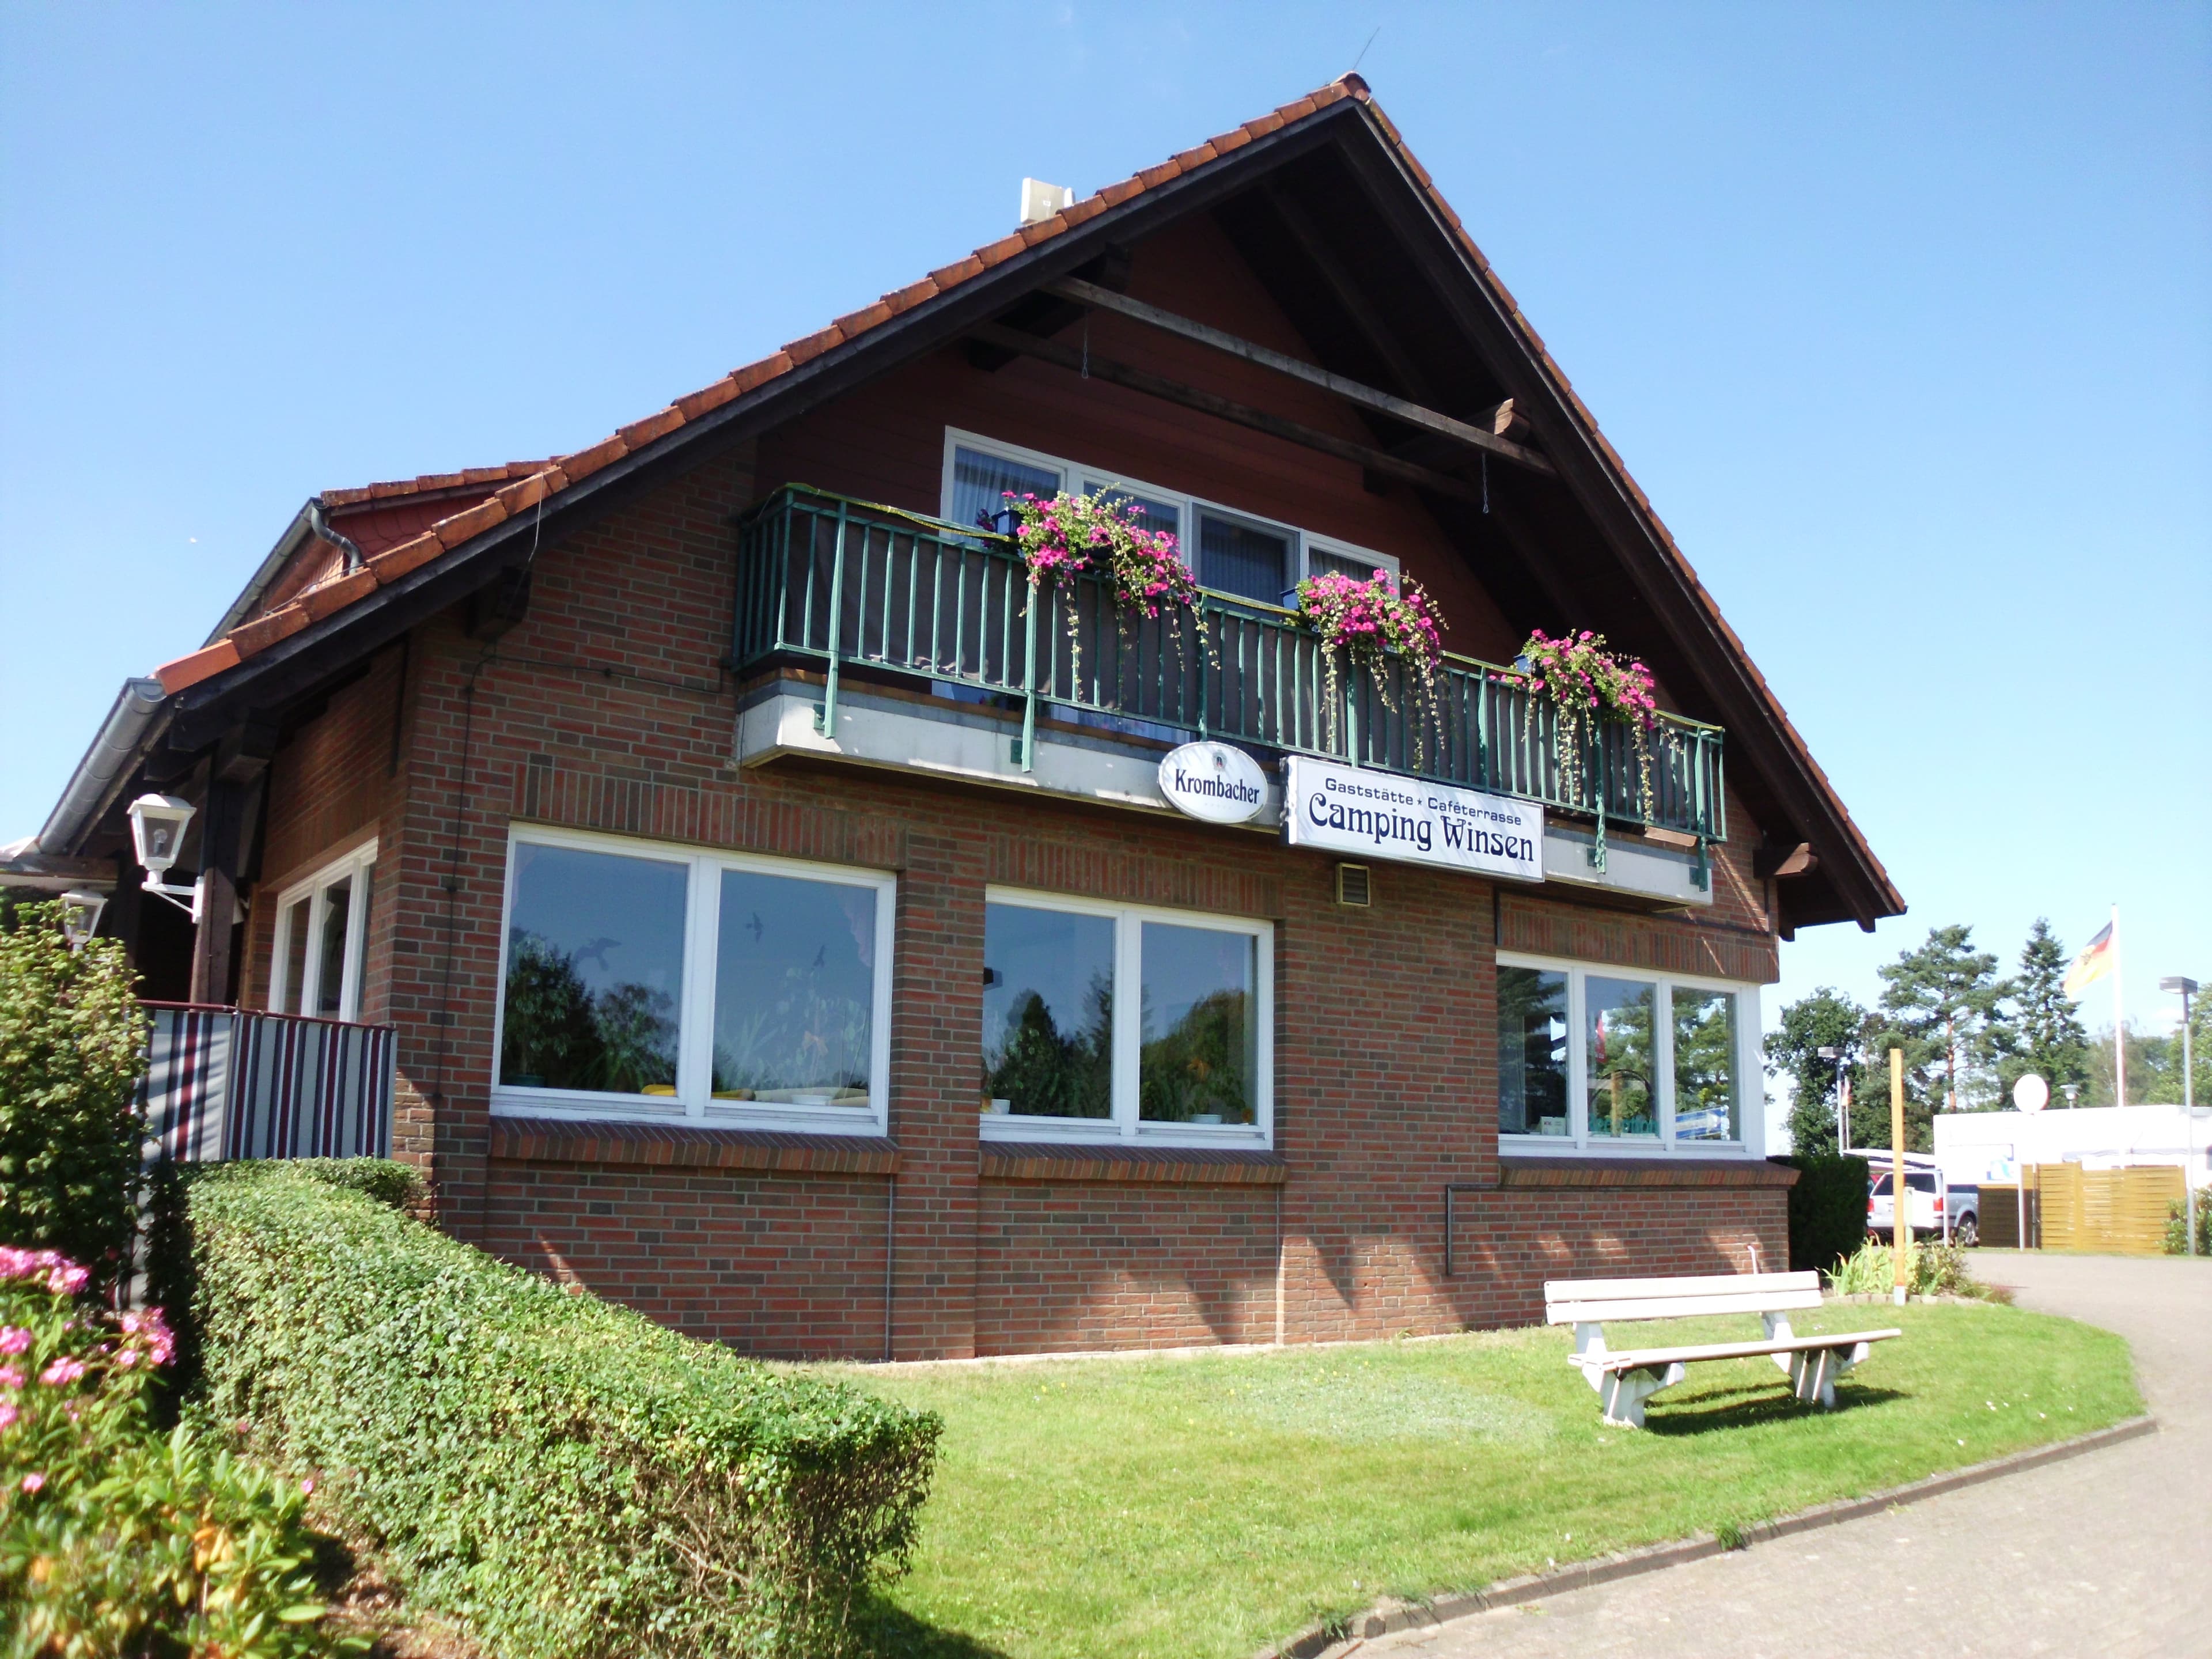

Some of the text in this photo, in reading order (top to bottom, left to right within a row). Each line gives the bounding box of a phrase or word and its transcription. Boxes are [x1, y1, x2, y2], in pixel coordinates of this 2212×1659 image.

[1175, 769, 1260, 804] Krombacher
[1325, 778, 1521, 825] Gaststätte Caféterrasse
[1309, 793, 1534, 862] Camping Winsen
